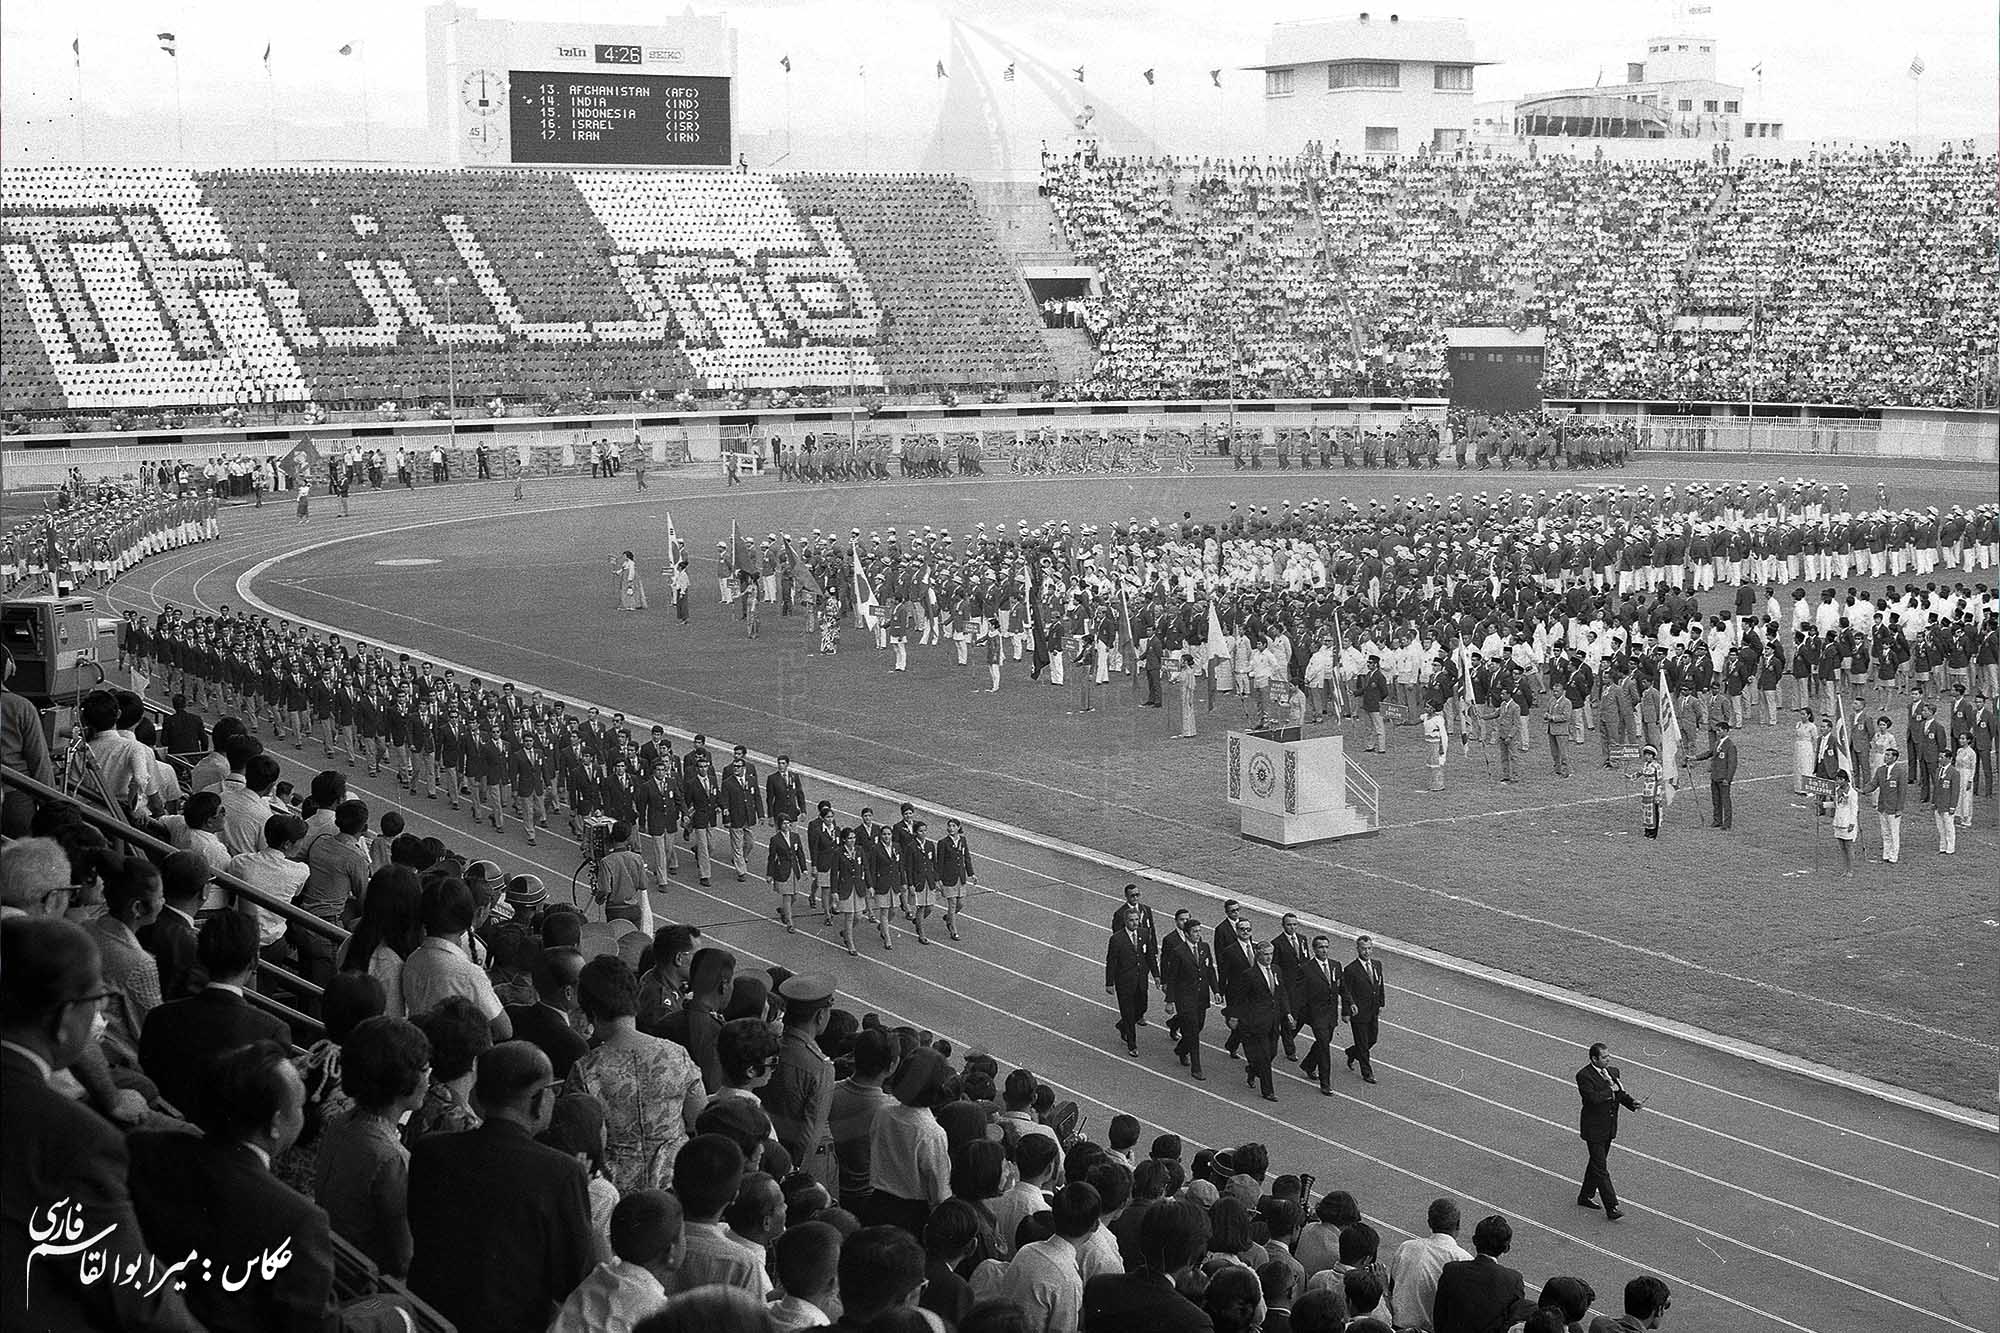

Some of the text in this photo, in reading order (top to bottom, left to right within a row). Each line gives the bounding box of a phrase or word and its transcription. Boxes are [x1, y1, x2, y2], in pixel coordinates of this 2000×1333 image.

[604, 46, 640, 63] 4:26
[648, 50, 682, 60] SEIKO
[539, 84, 699, 98] 13. AFGHANISTAN (AFG)
[539, 96, 700, 109] 14. INDIA (IND)
[540, 107, 700, 120] 15. INDONESIA (IDS)
[540, 118, 700, 131] 16. ISRAEL (ISR)
[540, 130, 700, 142] 17. IRAN (IRN)
